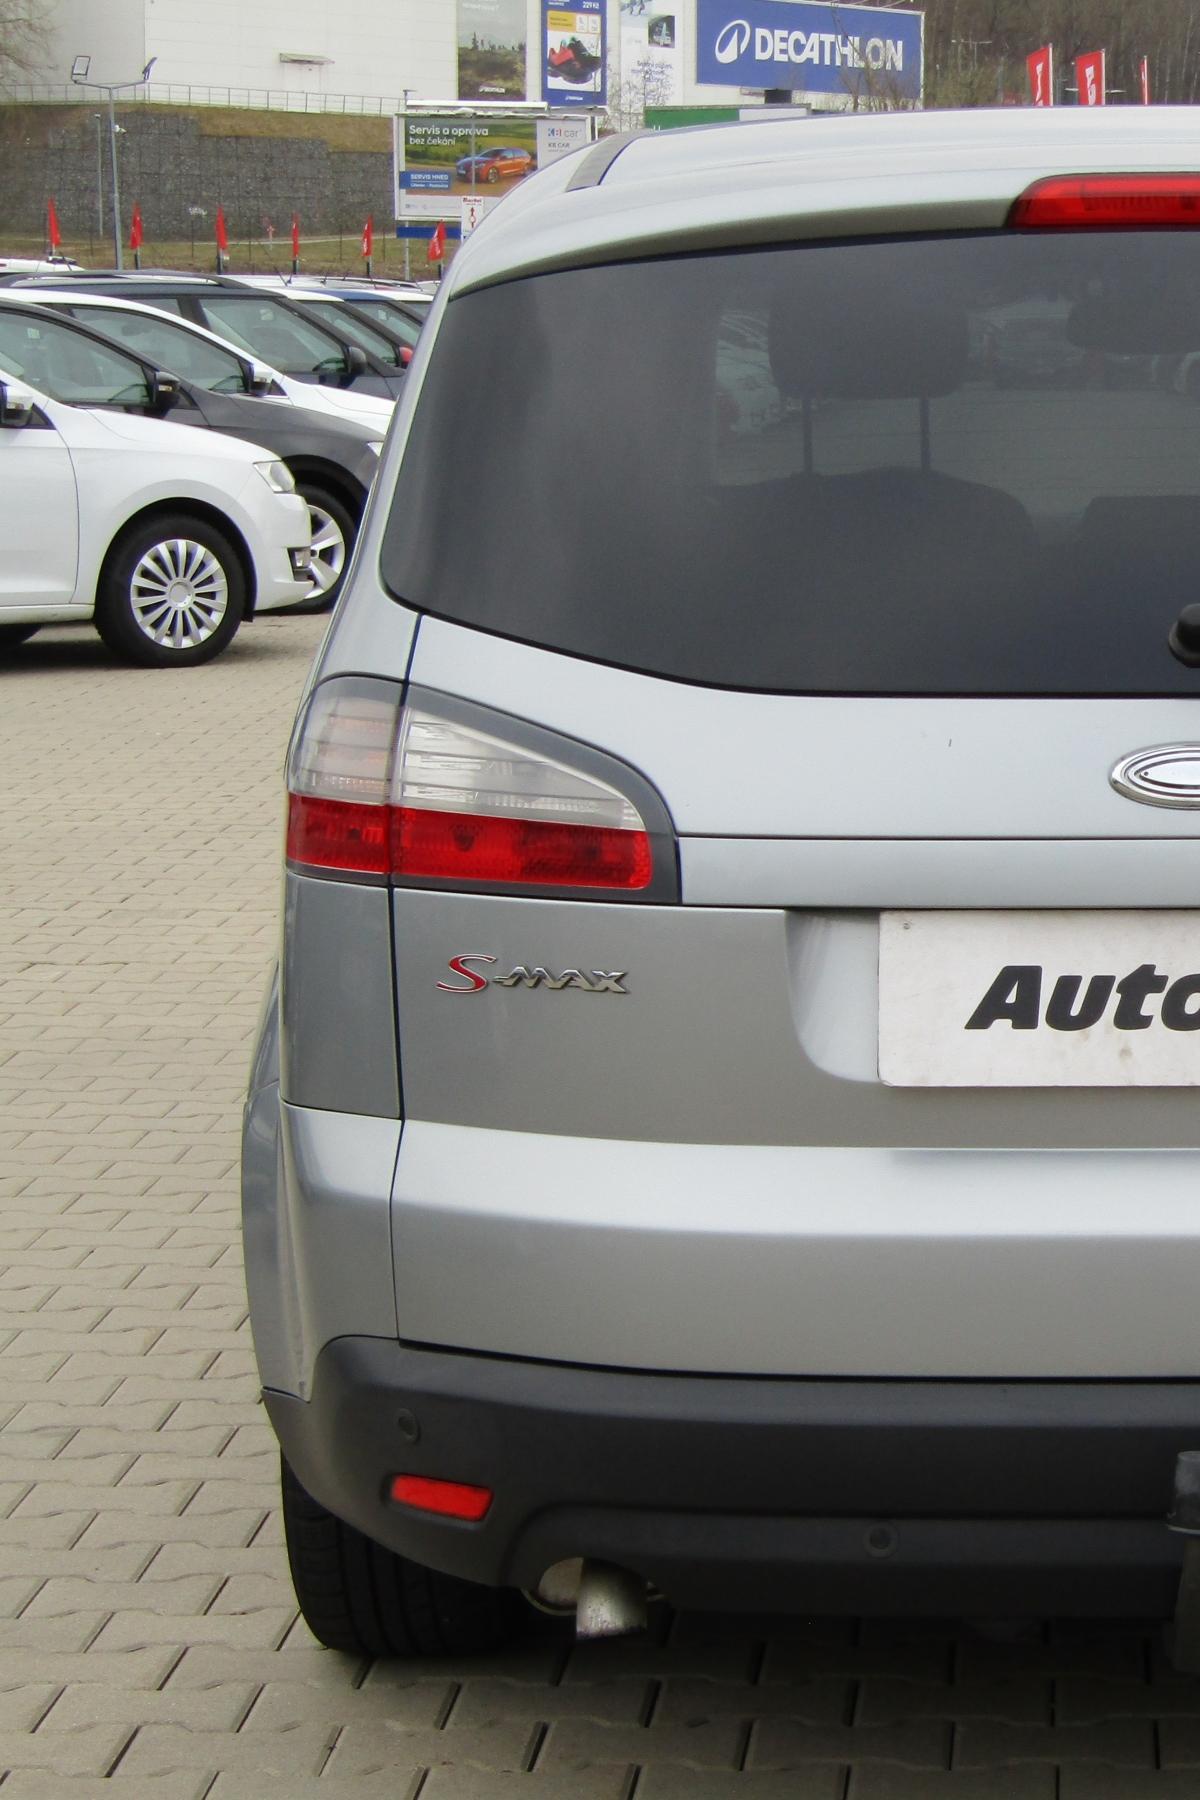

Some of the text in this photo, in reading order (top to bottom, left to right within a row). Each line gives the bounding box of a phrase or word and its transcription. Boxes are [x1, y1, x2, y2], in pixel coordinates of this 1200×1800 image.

[754, 27, 904, 72] DECATHLON
[409, 125, 489, 137] Servis a oprava
[409, 136, 456, 146] bez čekání
[436, 953, 629, 993] S-MAX
